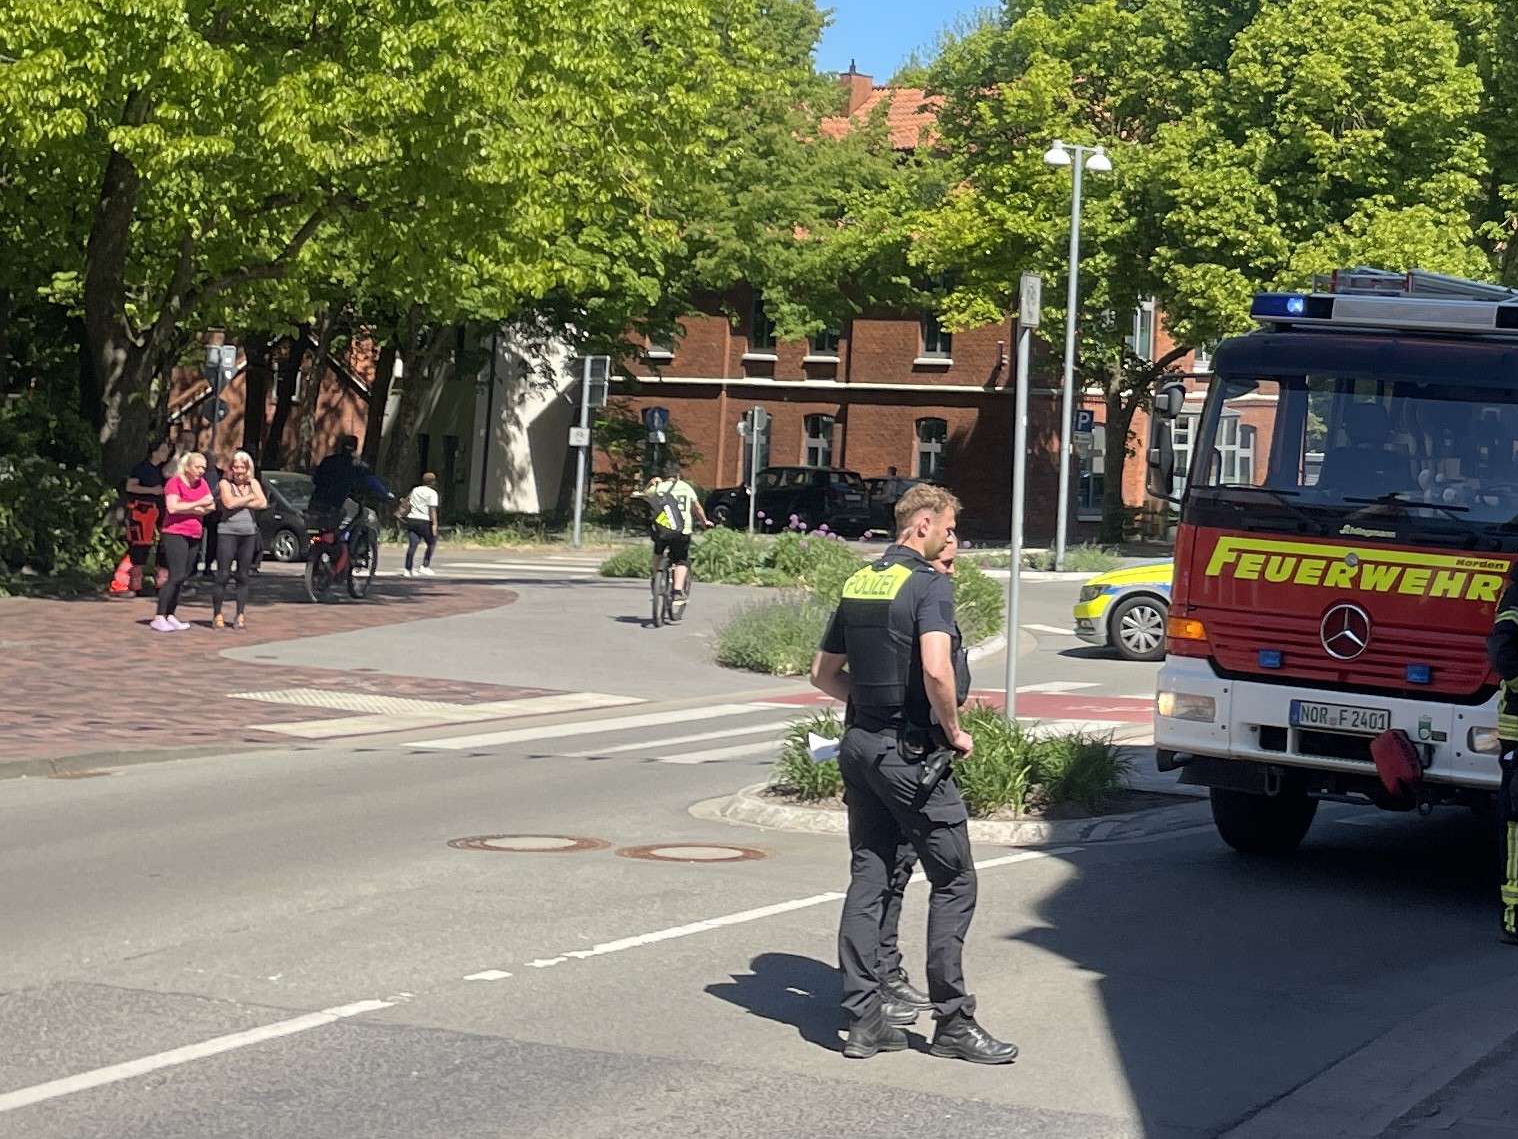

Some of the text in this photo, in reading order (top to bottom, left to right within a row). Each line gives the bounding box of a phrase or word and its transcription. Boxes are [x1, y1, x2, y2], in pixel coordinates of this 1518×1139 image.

[1205, 536, 1506, 603] FEUERWEHR
[1455, 558, 1505, 570] Norden
[845, 574, 898, 595] POLIZEI
[1301, 704, 1386, 730] NOR F 2401
